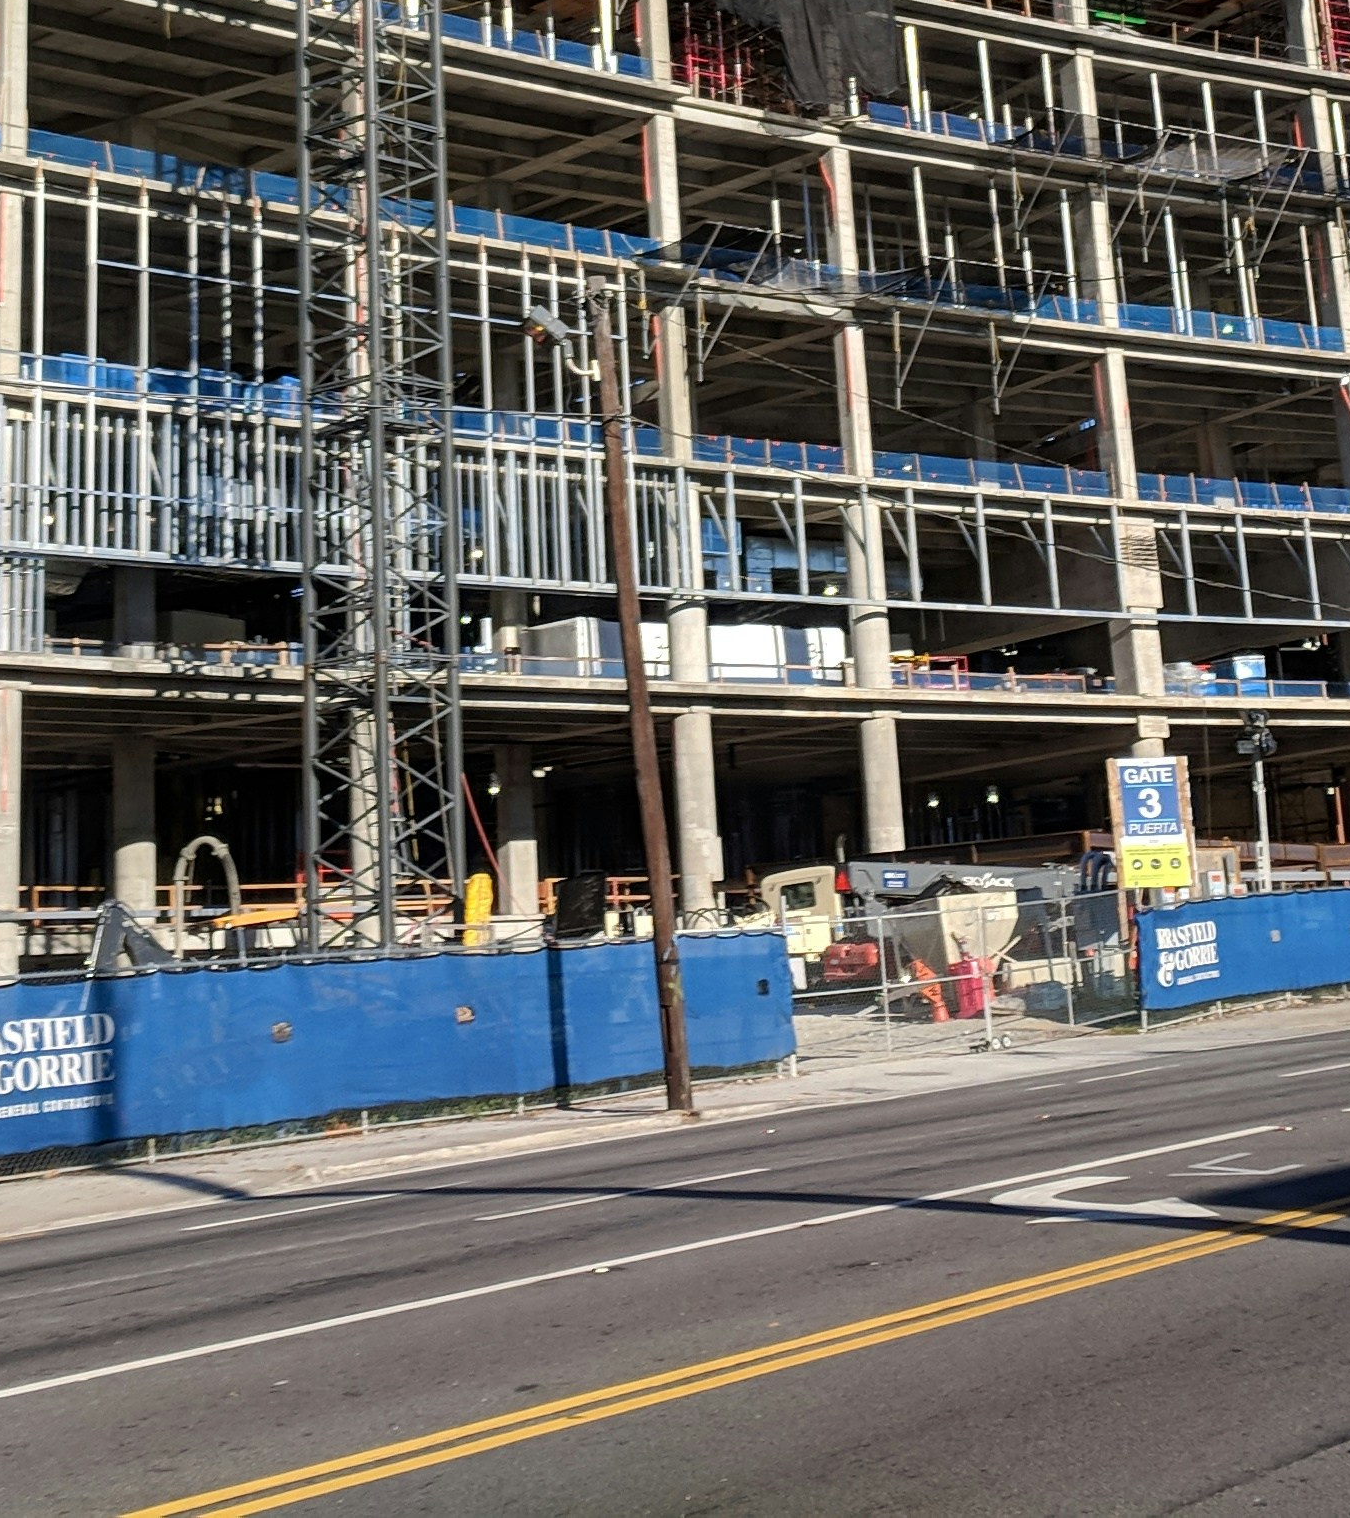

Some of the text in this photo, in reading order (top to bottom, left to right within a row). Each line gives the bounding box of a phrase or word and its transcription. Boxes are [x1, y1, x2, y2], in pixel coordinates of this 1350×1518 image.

[1124, 767, 1174, 784] GATE
[1137, 787, 1162, 819] 3
[1128, 822, 1179, 835] PUERTA
[1175, 942, 1220, 971] GORRIE
